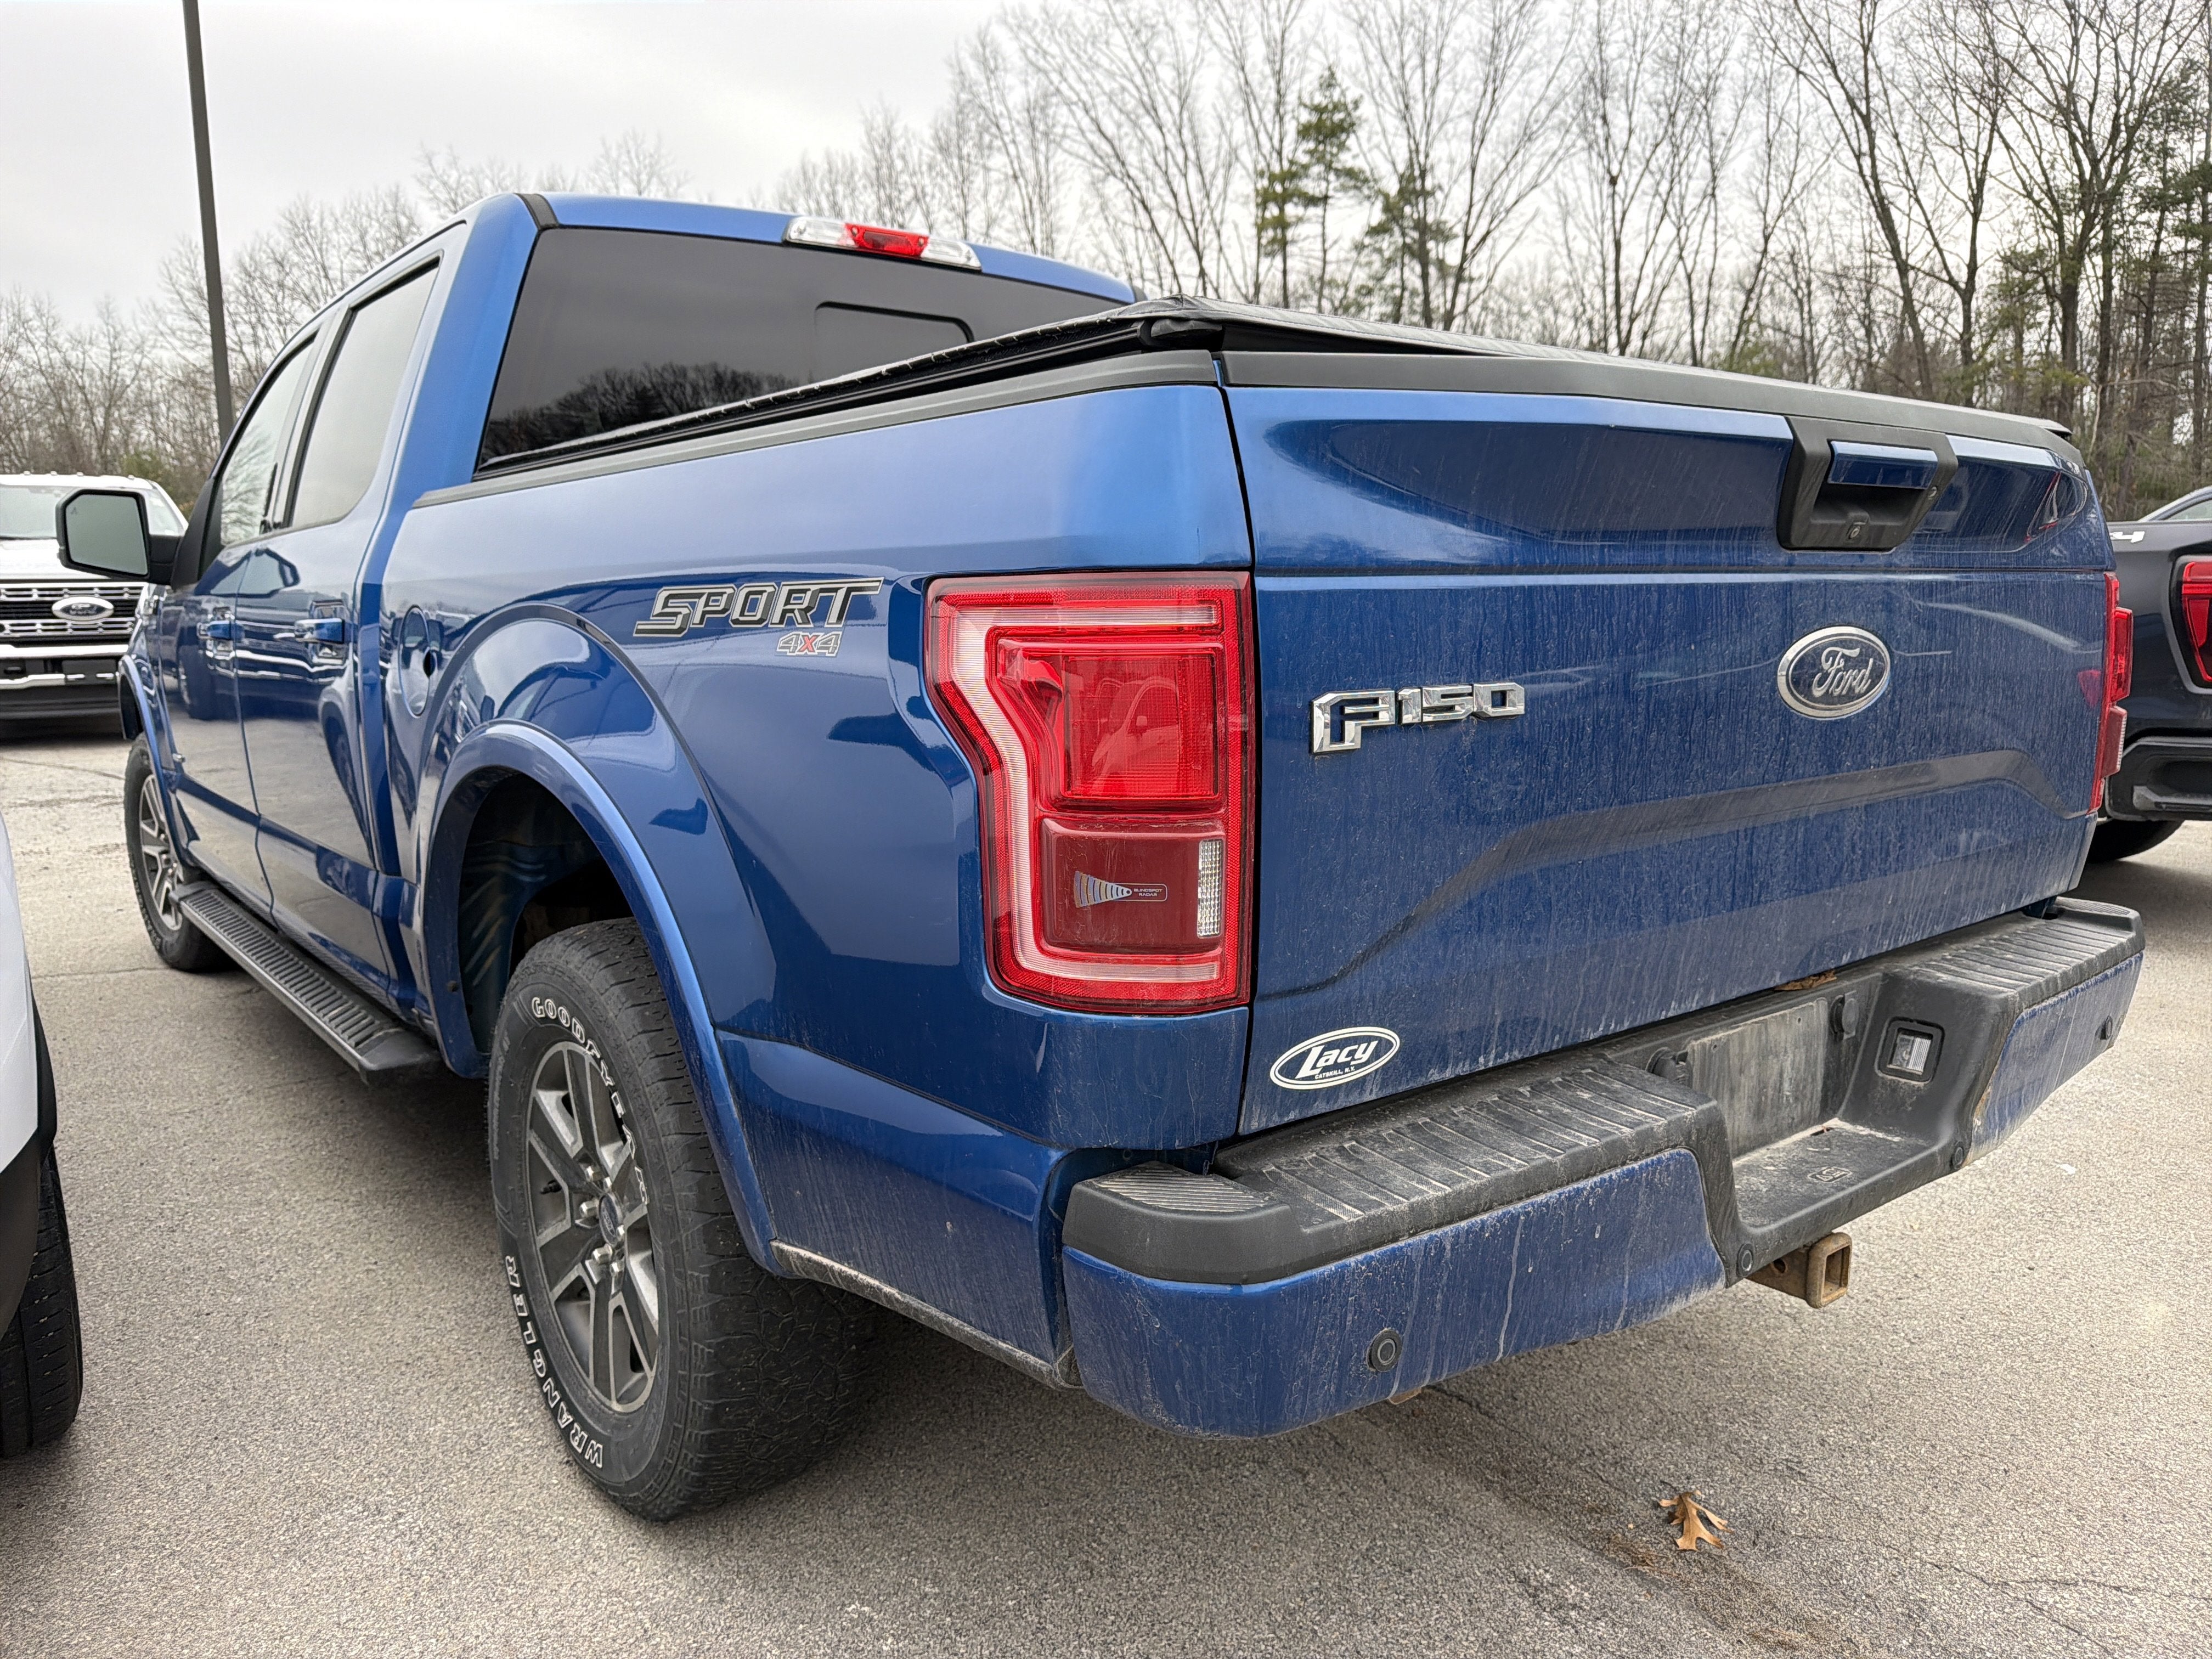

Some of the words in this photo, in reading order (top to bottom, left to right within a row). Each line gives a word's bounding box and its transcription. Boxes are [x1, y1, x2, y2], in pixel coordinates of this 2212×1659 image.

[634, 577, 884, 637] SPORT
[1812, 646, 1874, 698] Ford
[1295, 1040, 1378, 1079] Lacy
[1314, 1069, 1343, 1080] CATSKILL,
[505, 1255, 603, 1468] WRANGLER
